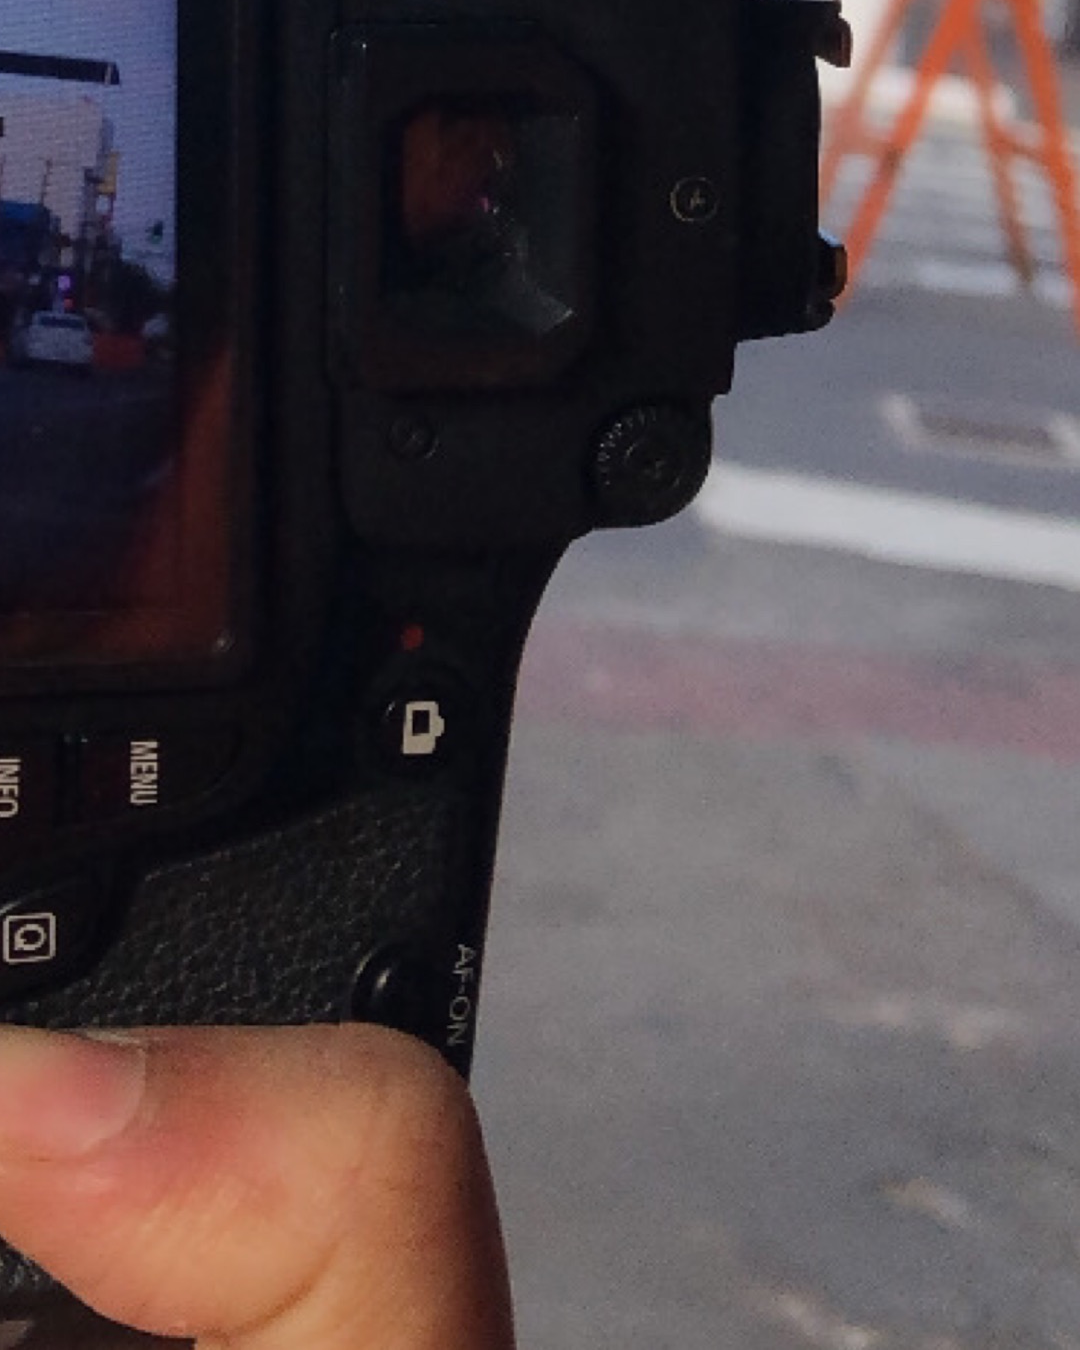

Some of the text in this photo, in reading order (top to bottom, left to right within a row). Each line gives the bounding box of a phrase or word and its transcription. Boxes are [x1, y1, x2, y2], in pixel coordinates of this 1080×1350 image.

[130, 740, 158, 806] MENU
[12, 924, 47, 952] Q
[446, 943, 477, 1047] AF-ON
